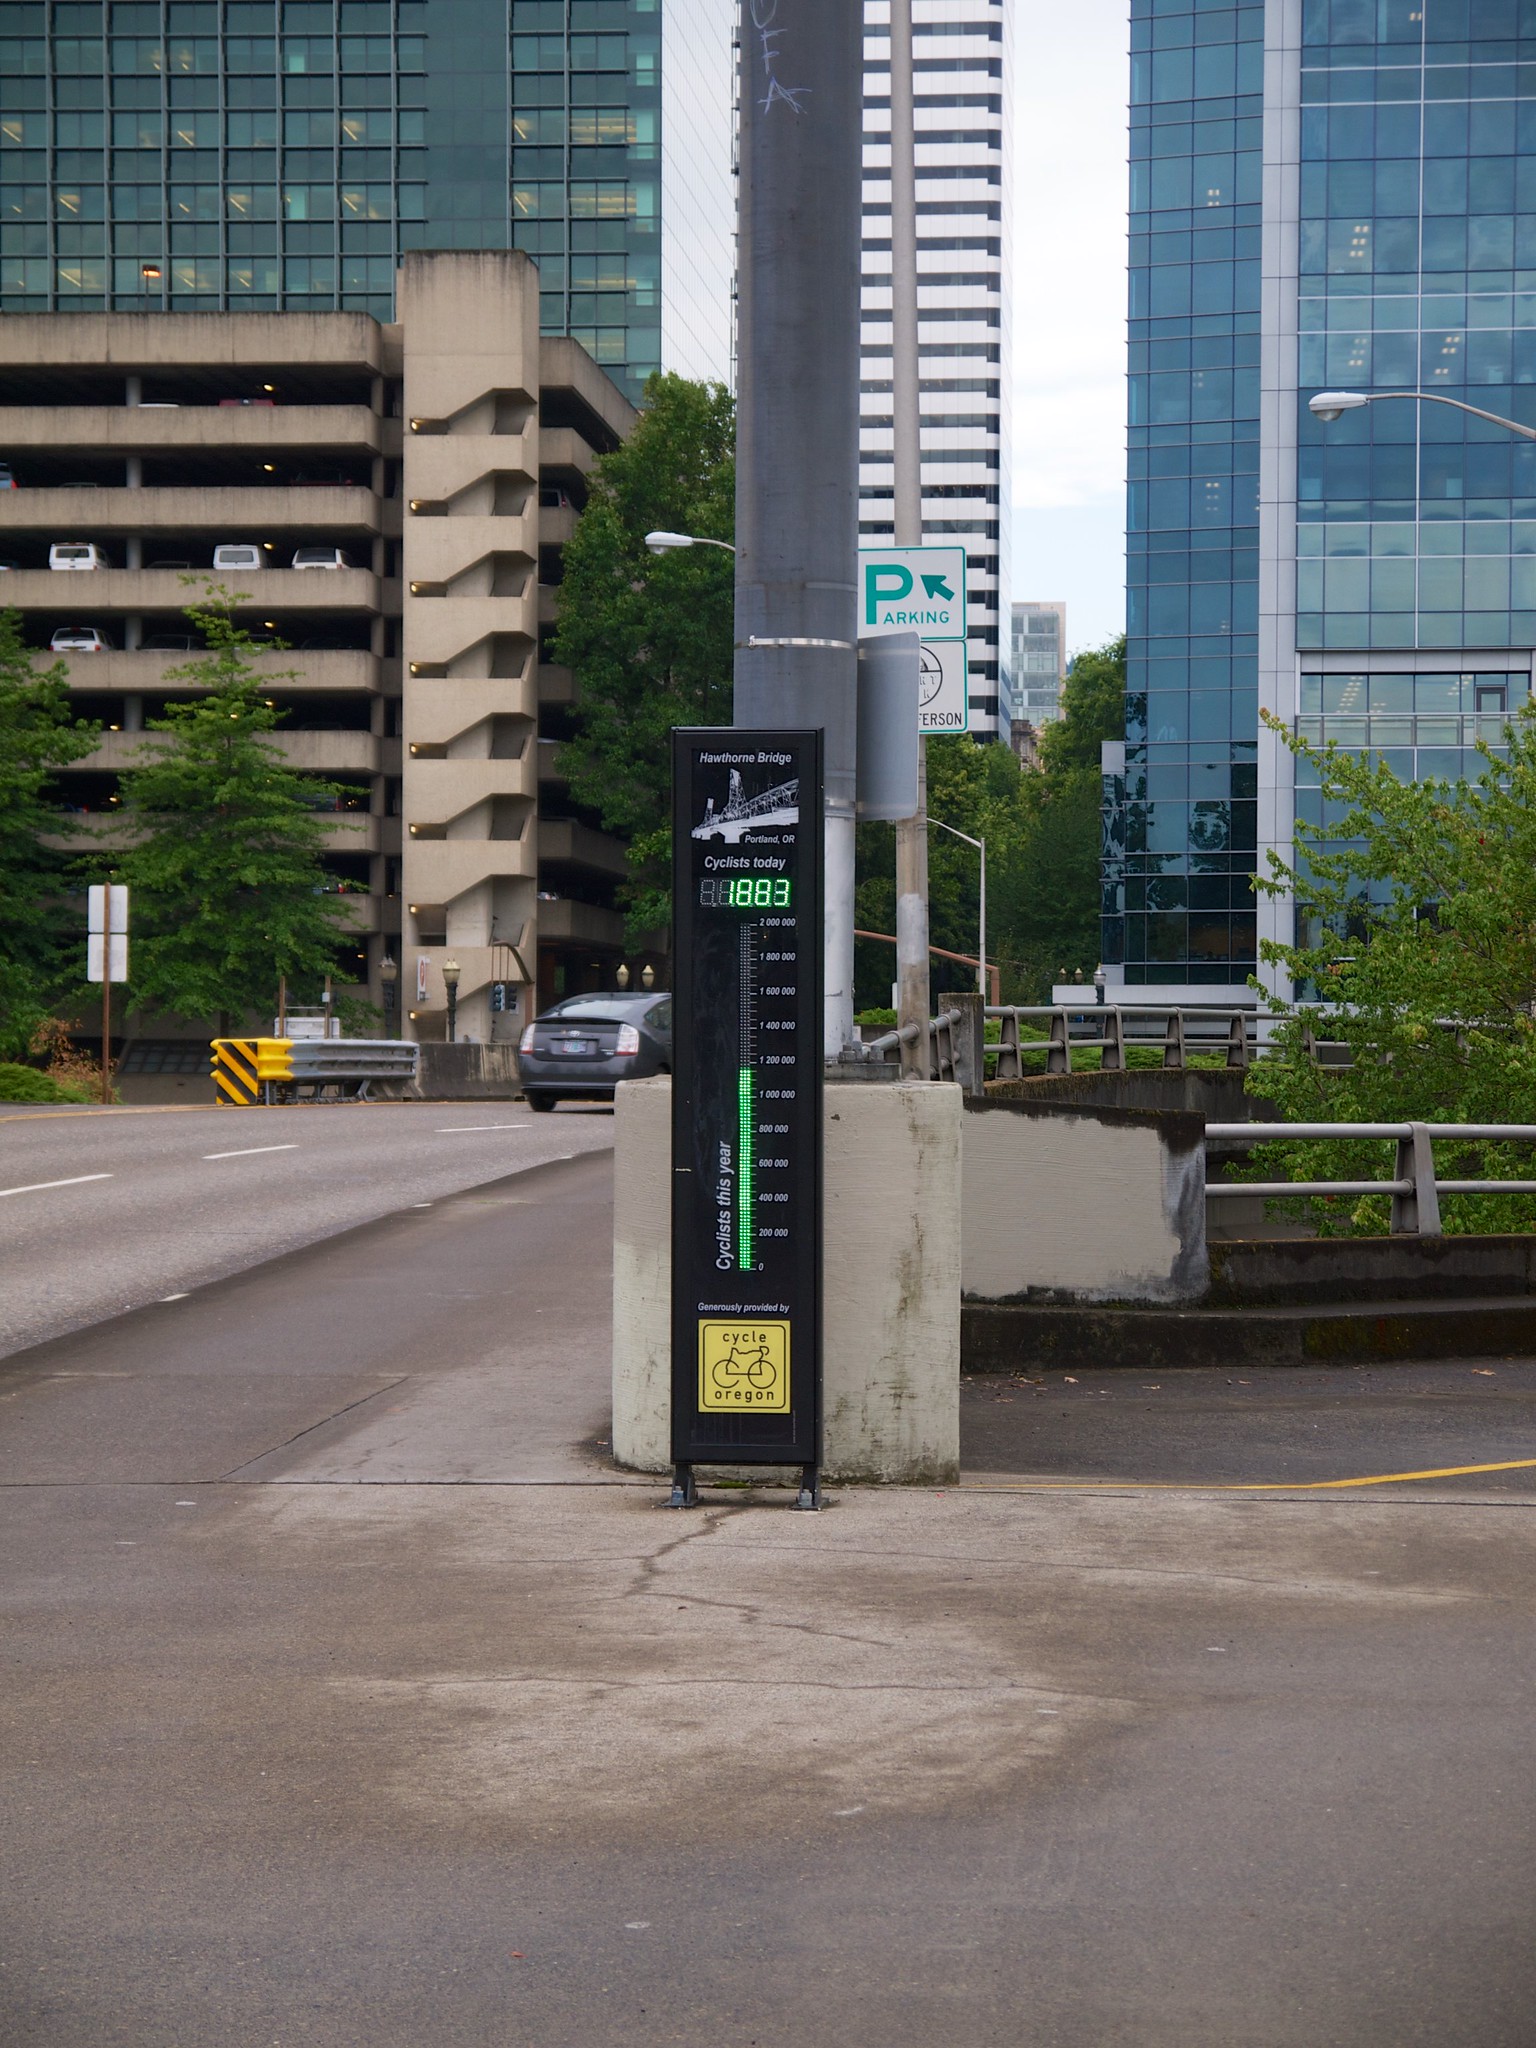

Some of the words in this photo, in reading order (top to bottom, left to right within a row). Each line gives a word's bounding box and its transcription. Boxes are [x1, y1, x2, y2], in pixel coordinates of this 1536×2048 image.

[866, 564, 950, 625] PARKING
[699, 752, 755, 763] Hawthorne
[757, 752, 792, 766] Bridge
[745, 835, 780, 845] Portland,
[782, 835, 796, 844] OR
[704, 856, 750, 871] Cyclists
[753, 856, 786, 871] today
[728, 879, 790, 906] 1883
[720, 1141, 734, 1175] year
[716, 1177, 731, 1206] this
[715, 1210, 734, 1270] Cyclists
[758, 1263, 764, 1271] 0
[698, 1302, 742, 1313] Generously
[743, 1303, 778, 1313] provided
[779, 1303, 790, 1314] by
[722, 1330, 767, 1345] cycle
[714, 1390, 774, 1403] oregon
